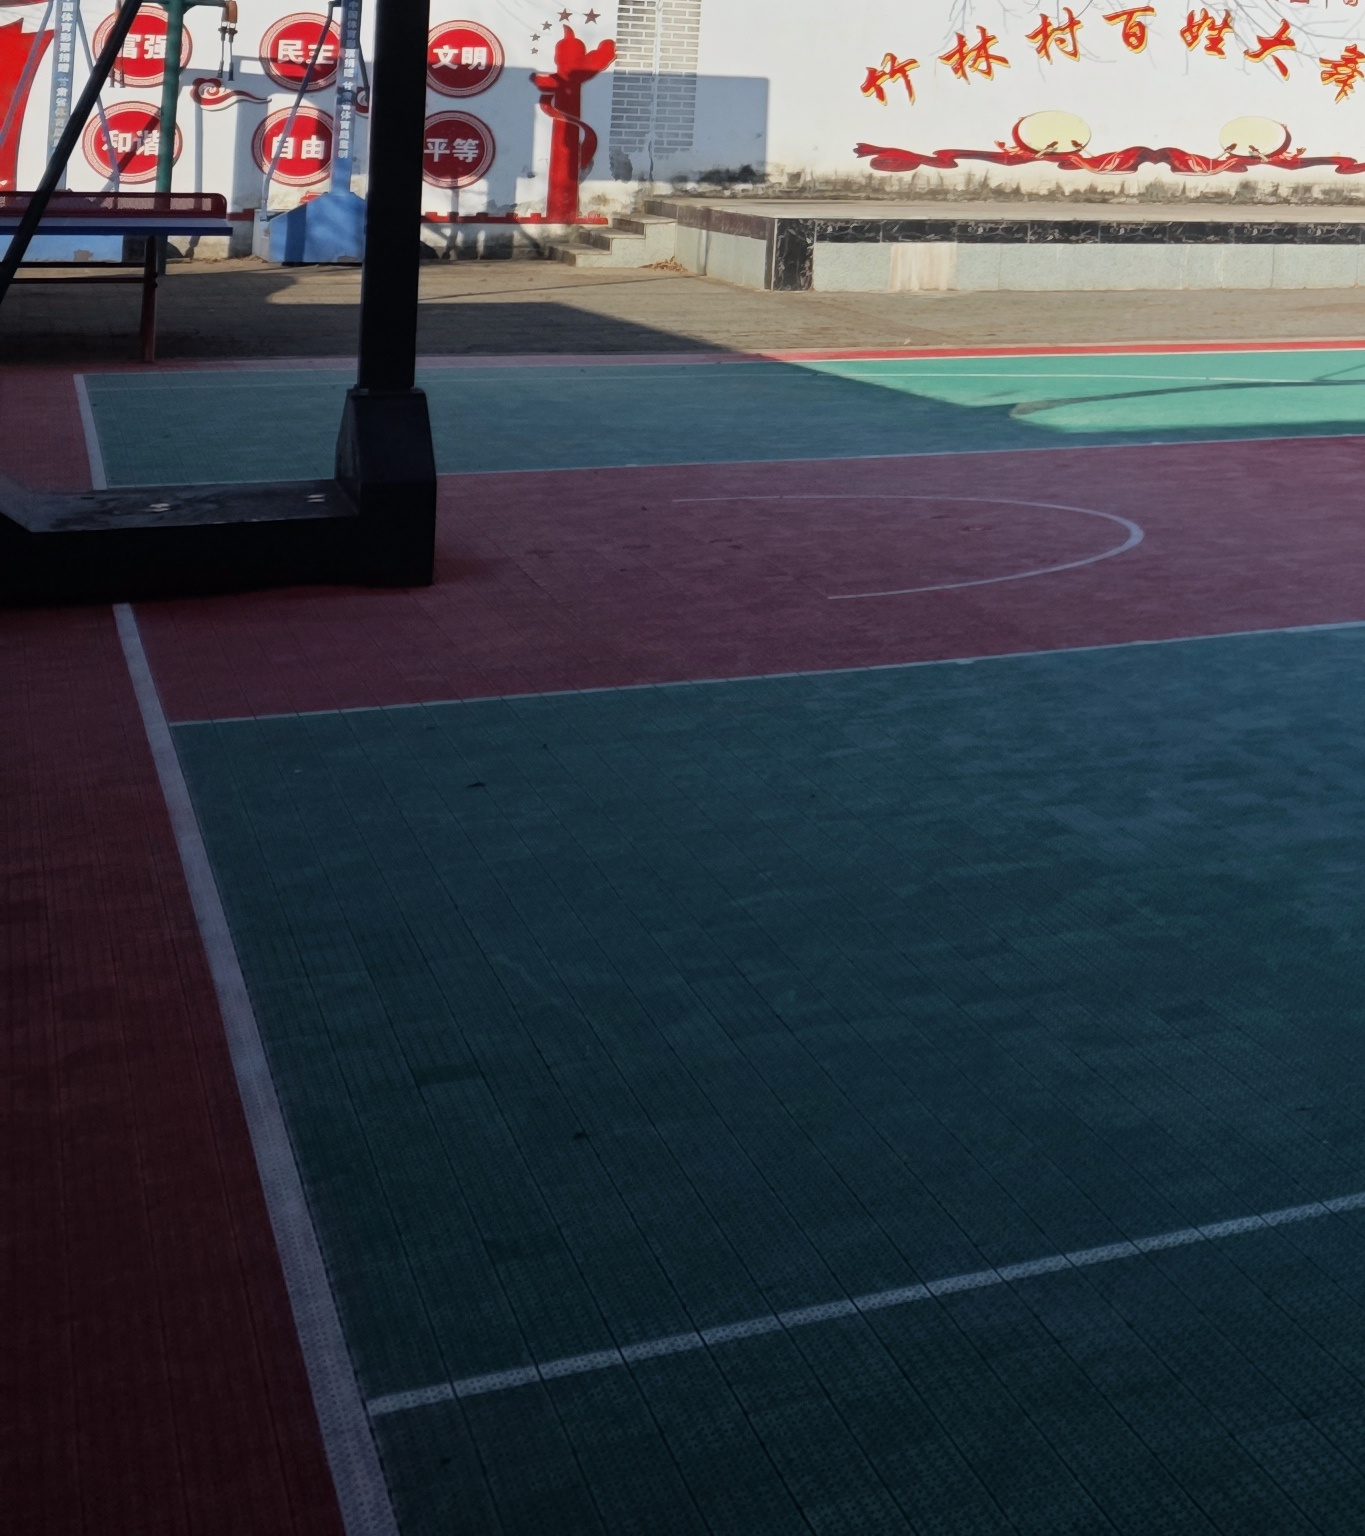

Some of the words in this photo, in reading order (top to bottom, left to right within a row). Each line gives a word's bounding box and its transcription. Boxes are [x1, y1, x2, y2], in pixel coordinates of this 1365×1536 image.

[277, 39, 335, 66] 民主
[432, 45, 488, 71] 文明
[271, 135, 326, 160] 自由
[424, 138, 480, 163] 平等
